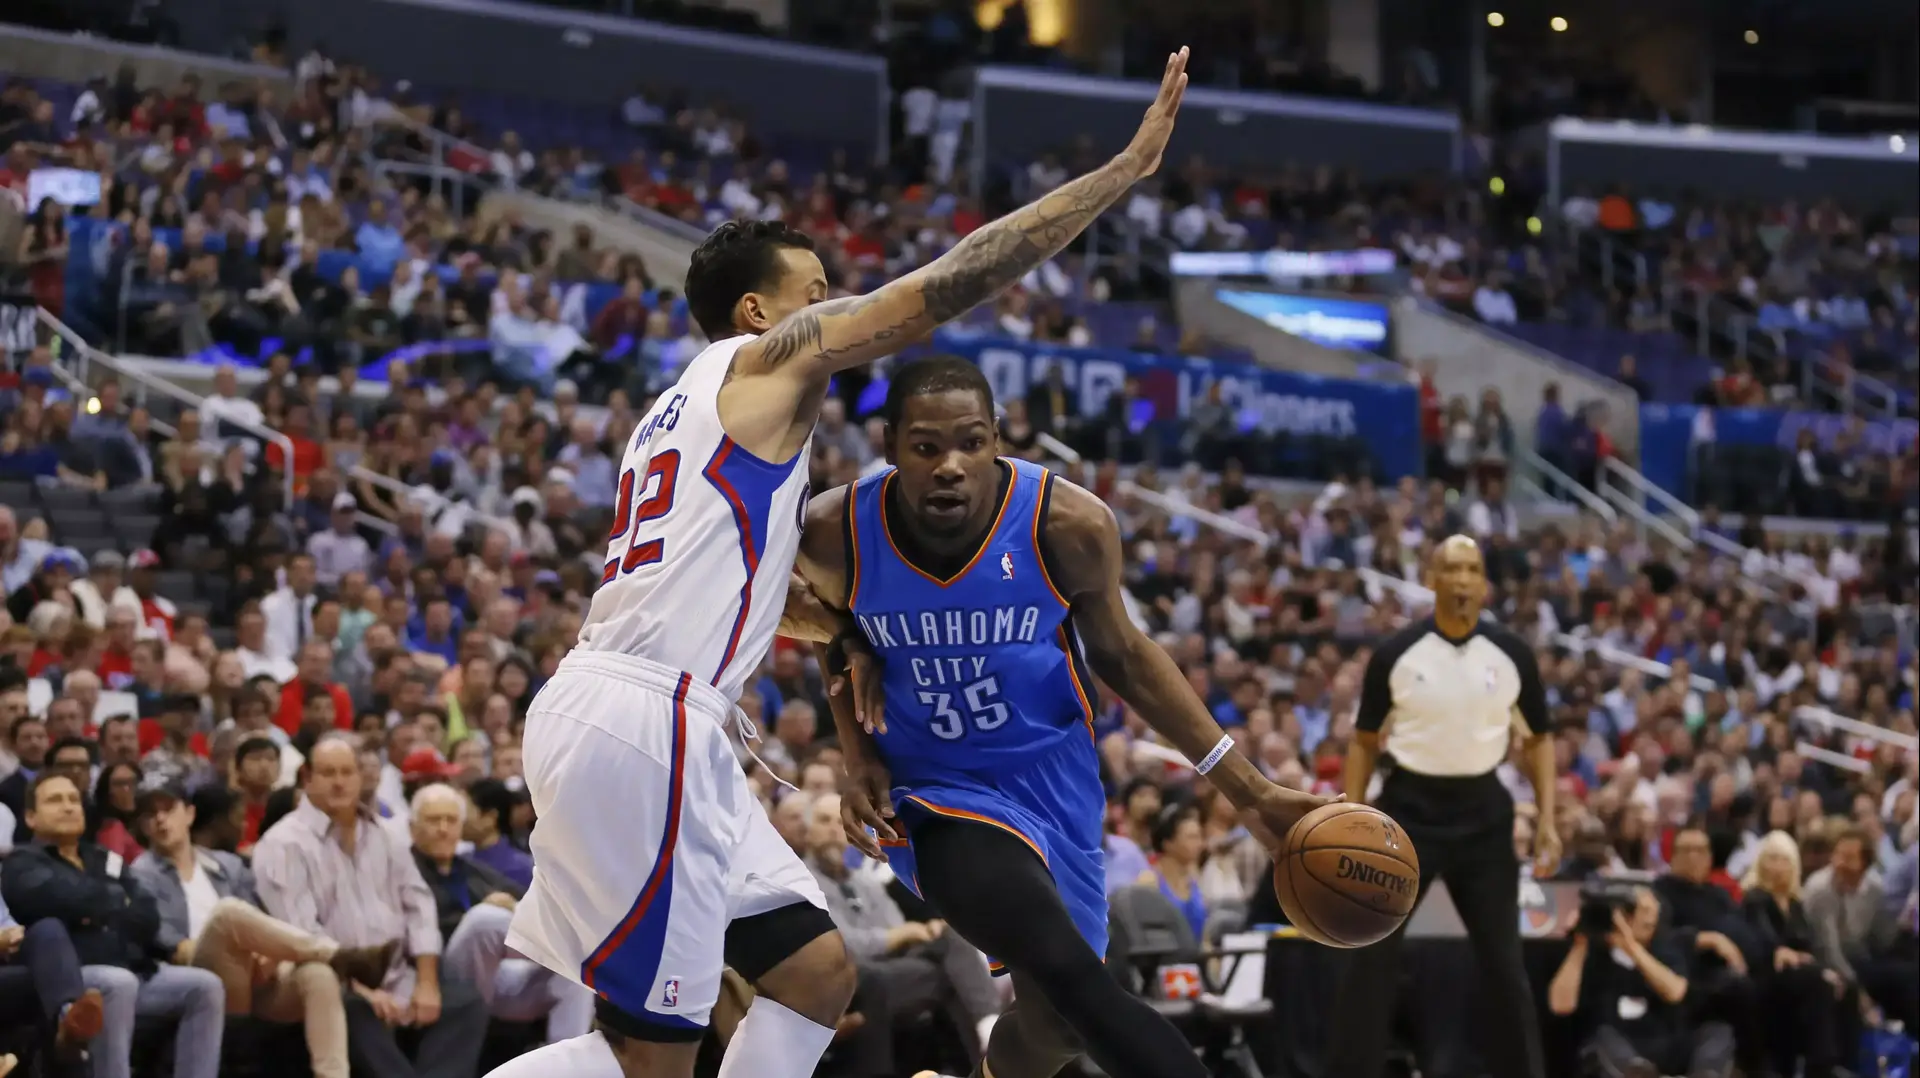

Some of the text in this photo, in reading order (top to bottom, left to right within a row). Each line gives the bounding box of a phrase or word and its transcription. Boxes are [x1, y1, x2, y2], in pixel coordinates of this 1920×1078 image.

[634, 393, 688, 453] BAES
[600, 448, 681, 587] 22
[858, 606, 1039, 648] OKLAHOMA
[911, 655, 986, 687] CITY
[916, 674, 1010, 741] 35
